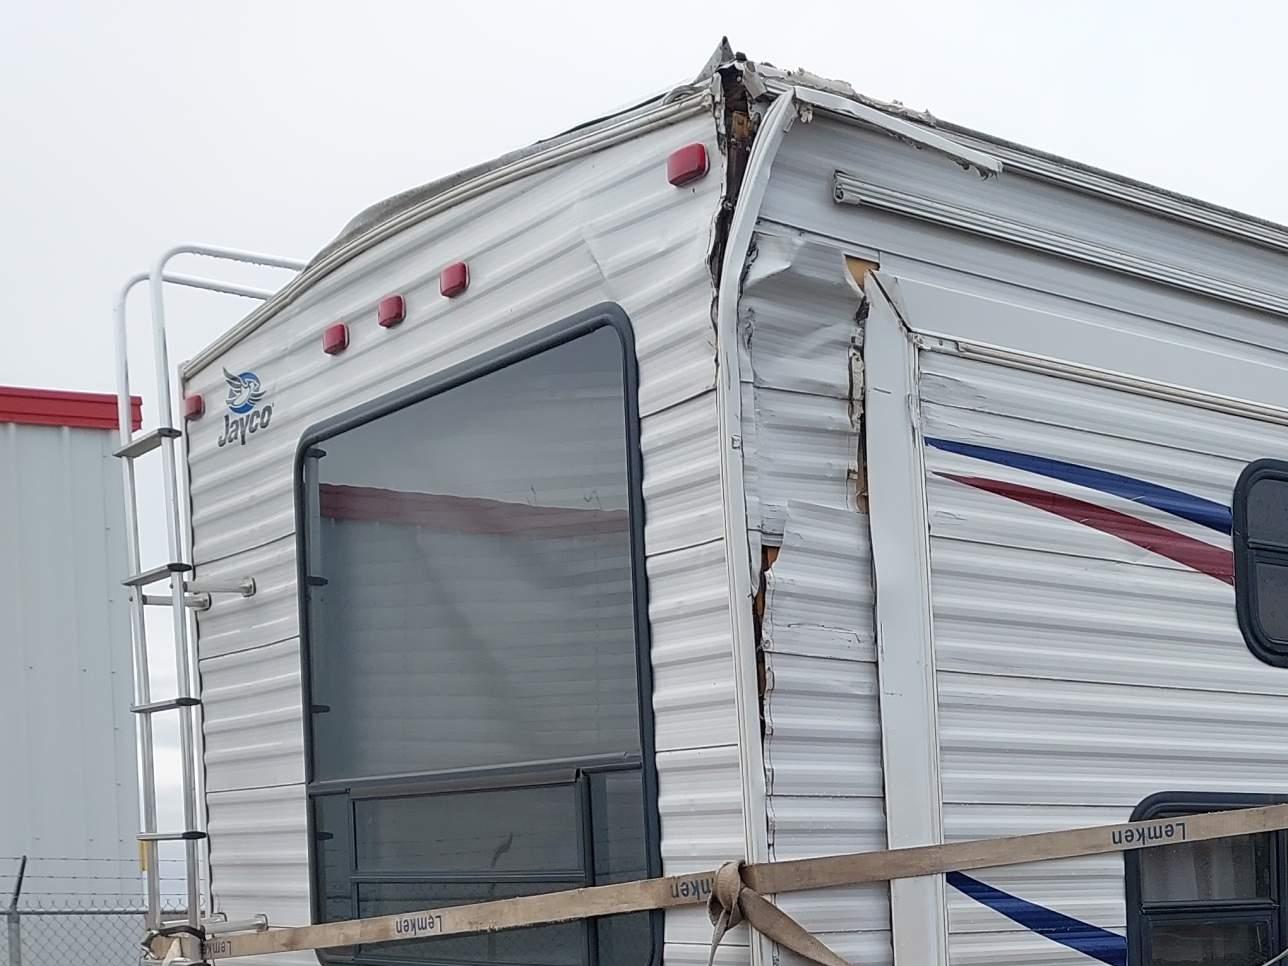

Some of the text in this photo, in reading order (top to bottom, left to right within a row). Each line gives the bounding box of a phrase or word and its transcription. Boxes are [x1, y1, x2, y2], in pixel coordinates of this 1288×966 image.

[218, 405, 273, 447] Jayco
[1112, 823, 1186, 845] Lemken
[671, 878, 714, 900] mken
[396, 915, 442, 936] Lemken
